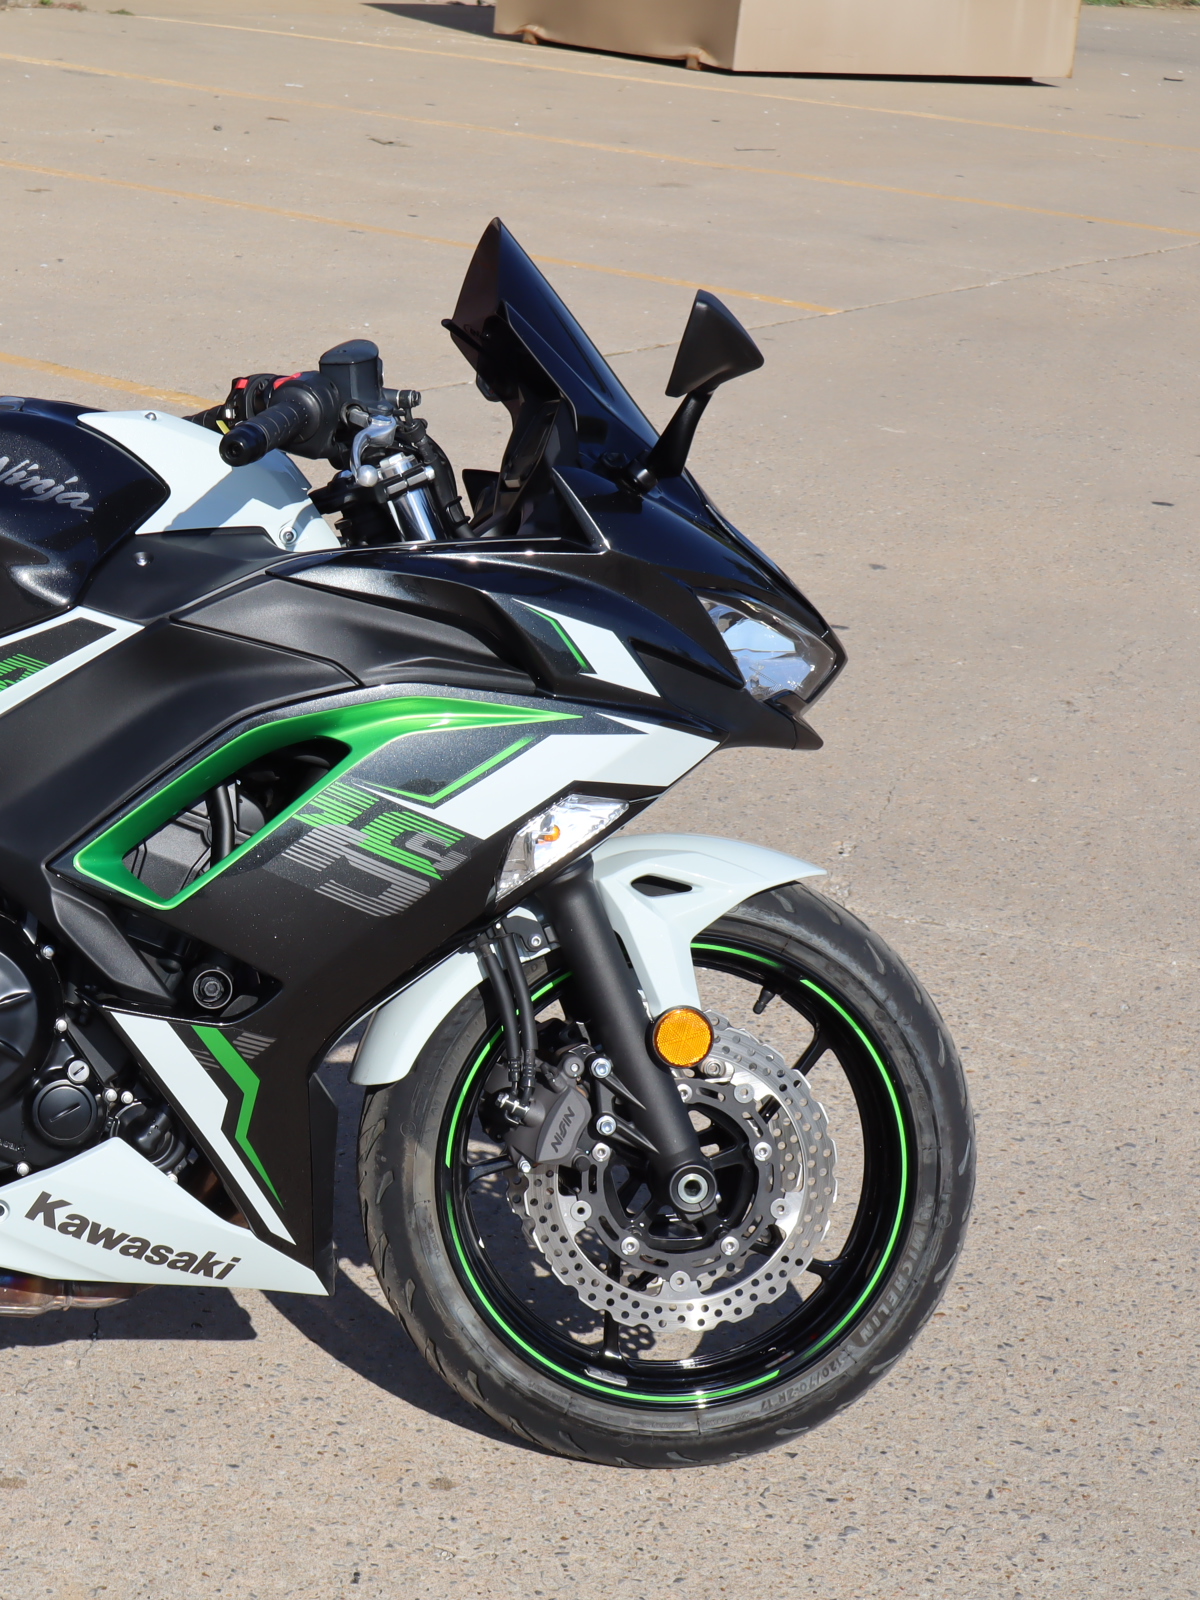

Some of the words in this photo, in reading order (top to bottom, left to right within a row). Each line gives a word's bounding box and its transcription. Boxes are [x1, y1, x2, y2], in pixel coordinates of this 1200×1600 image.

[24, 1190, 242, 1281] Kawasaki
[858, 1222, 927, 1343] MICHELIN
[800, 1356, 842, 1393] 120/70
